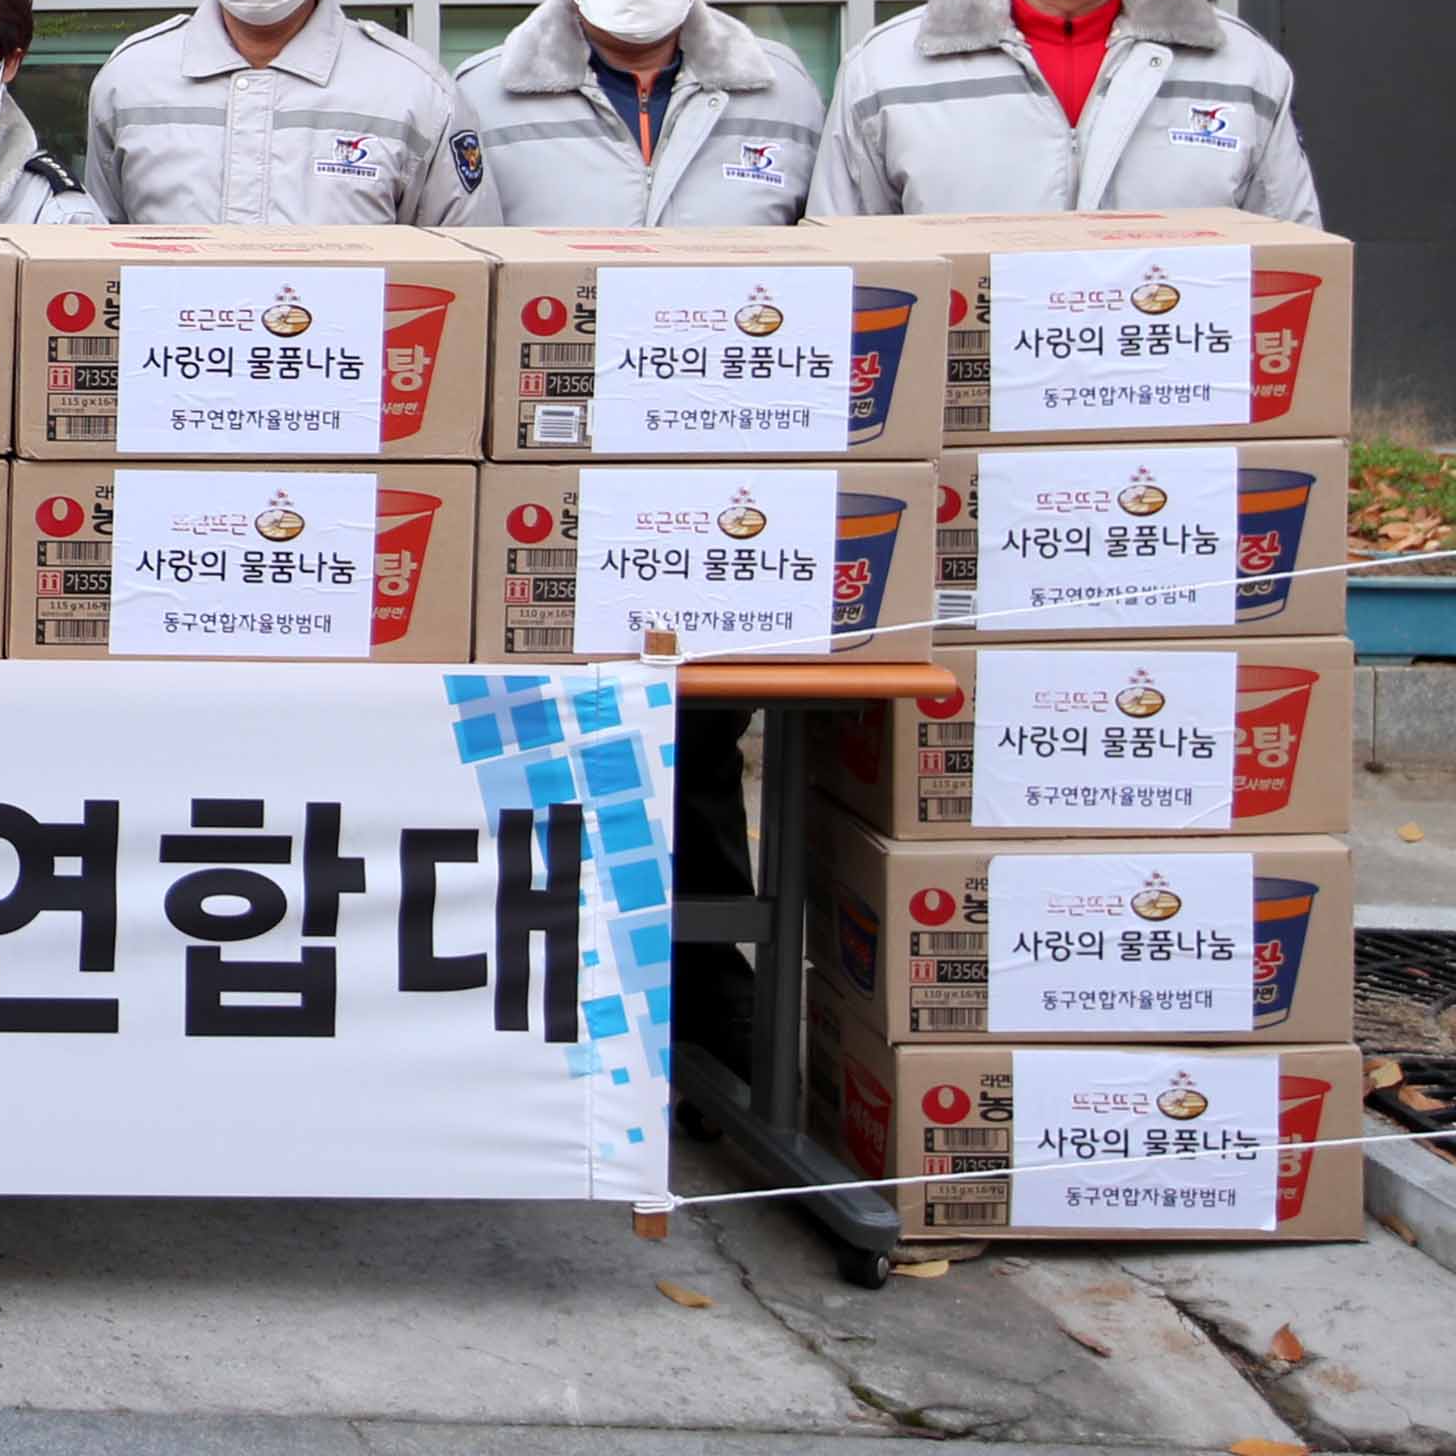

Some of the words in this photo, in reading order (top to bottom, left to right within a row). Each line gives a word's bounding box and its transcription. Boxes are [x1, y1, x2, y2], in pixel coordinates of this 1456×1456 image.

[1014, 325, 1104, 360] 사랑의
[1117, 322, 1233, 357] 물품나눔
[142, 345, 234, 380] 사랑의
[246, 346, 365, 381] 물품나눔
[618, 346, 707, 380] 사랑의
[720, 346, 834, 380] 물품나눔
[1044, 384, 1211, 409] 동구연합자율방범대
[170, 409, 340, 432] 동구연합자율방범대
[645, 408, 810, 431] 동구연합자율방범대
[1001, 526, 1091, 560] 사랑의
[1104, 523, 1220, 558] 물품나눔
[135, 549, 227, 583] 사랑의
[239, 550, 357, 585] 물품나눔
[600, 548, 690, 582] 사랑의
[703, 548, 817, 582] 물품나눔
[162, 612, 332, 635] 동구연합자율방범대
[997, 725, 1088, 758] 사랑의
[1101, 726, 1217, 759] 물품나눔
[1025, 786, 1193, 808] 동구연합자율방범대
[1012, 930, 1104, 963] 사랑의
[1117, 929, 1236, 962] 물품나눔
[1042, 989, 1213, 1011] 동구연합자율방범대
[1037, 1127, 1129, 1160] 사랑의
[1065, 1186, 1236, 1209] 동구연합자율방범대
